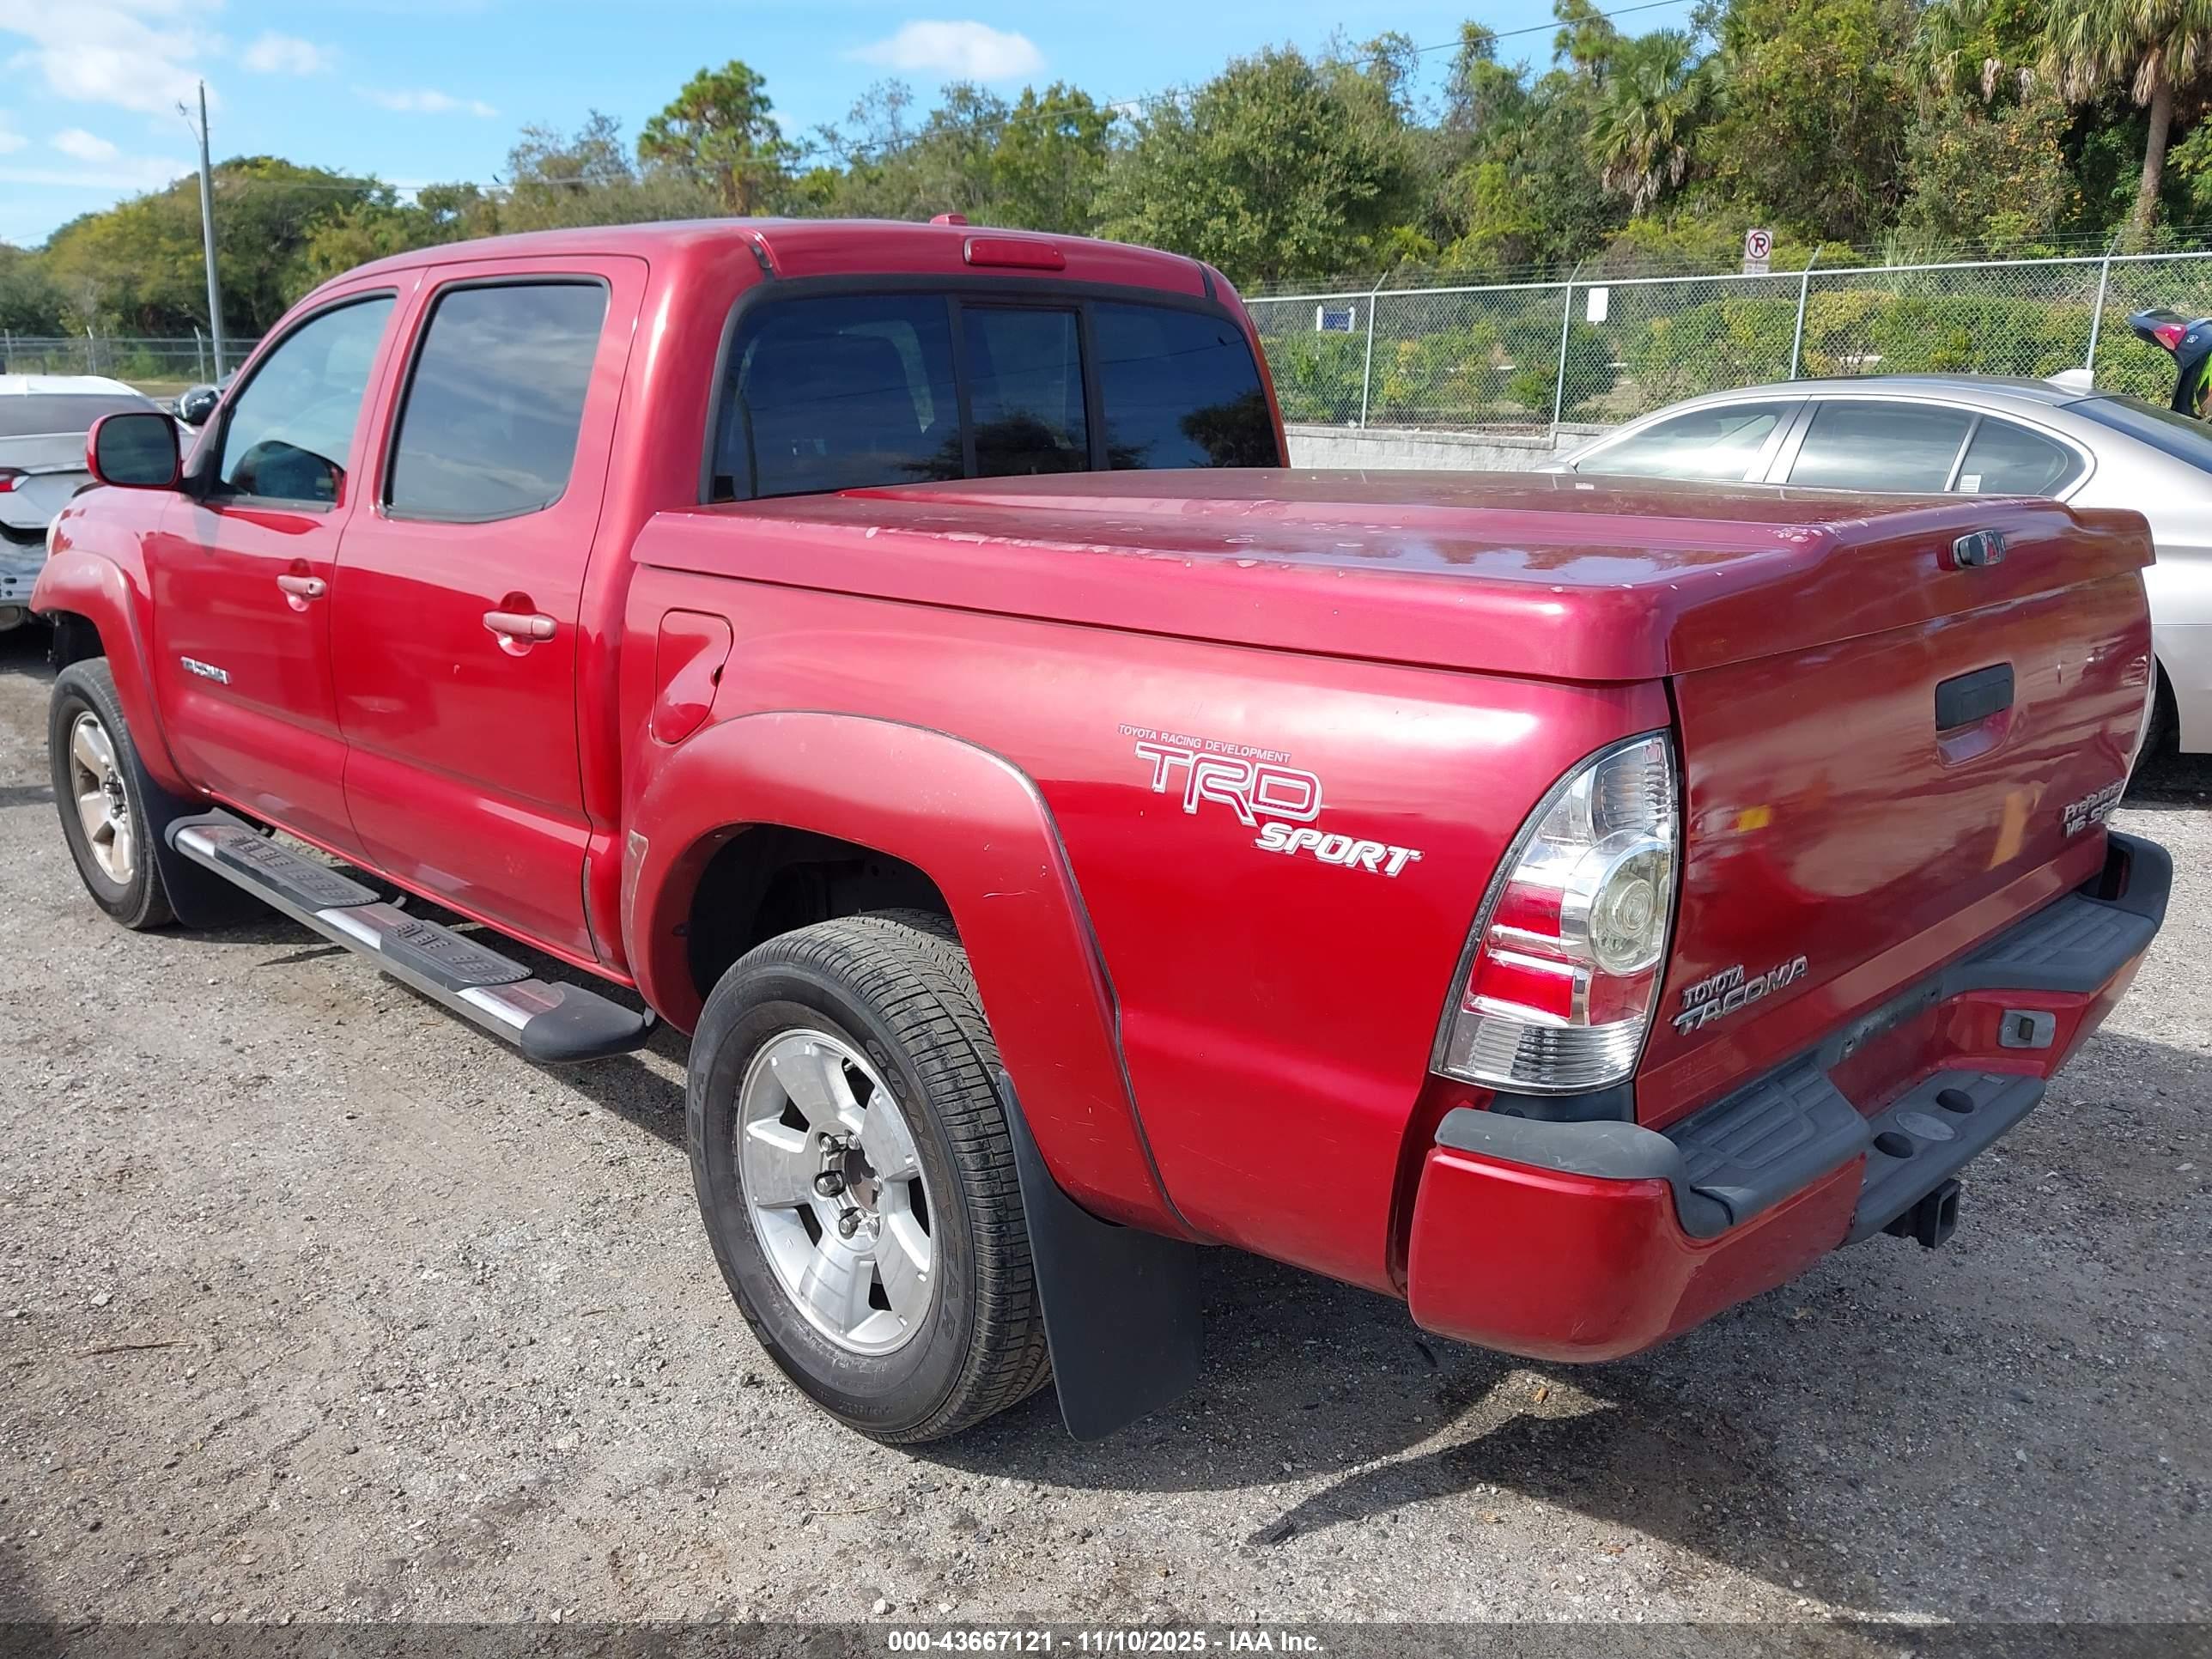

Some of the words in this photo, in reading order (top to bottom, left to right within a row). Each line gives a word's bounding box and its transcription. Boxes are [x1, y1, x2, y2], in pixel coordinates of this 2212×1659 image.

[1119, 724, 1157, 740] TOYOTA
[1160, 732, 1201, 750] RACING
[1205, 740, 1291, 763] DEVELOPMENT
[1134, 740, 1322, 827] TRD
[1255, 821, 1423, 878] SPORT
[2066, 814, 2087, 839] V6
[1671, 955, 1808, 1036] TACOMA
[1682, 964, 1745, 1010] TOYOTA
[866, 1038, 960, 1341] GOODYEAR
